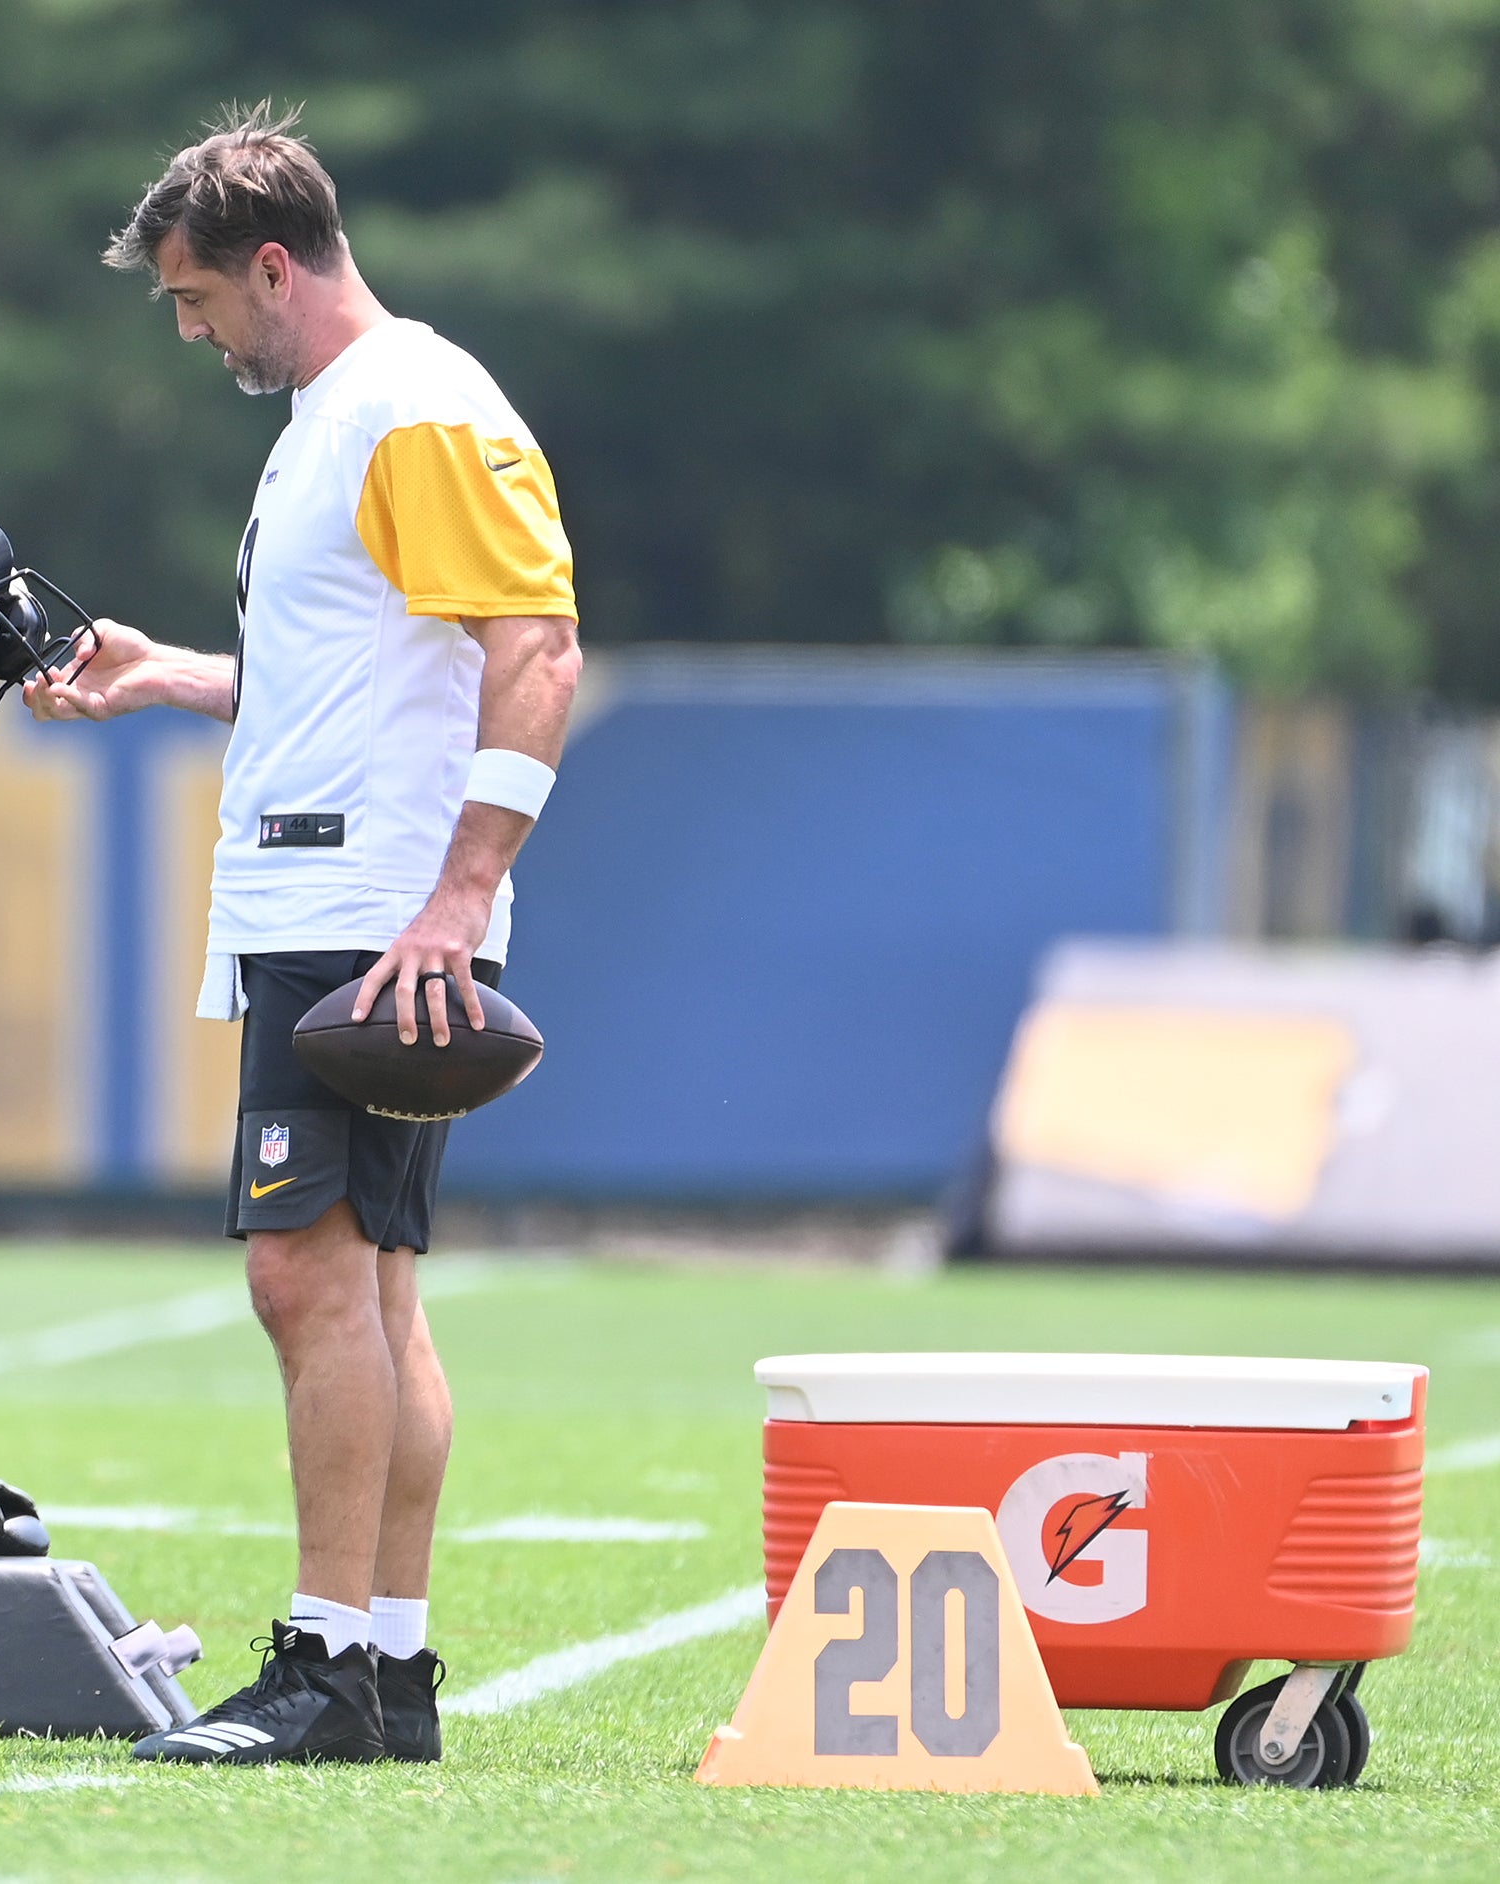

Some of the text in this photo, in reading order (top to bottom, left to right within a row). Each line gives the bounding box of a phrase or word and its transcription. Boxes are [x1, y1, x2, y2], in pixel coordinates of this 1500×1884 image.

[290, 817, 309, 830] 44
[264, 1142, 285, 1160] NFL
[993, 1451, 1148, 1625] G
[813, 1547, 1000, 1758] 20
